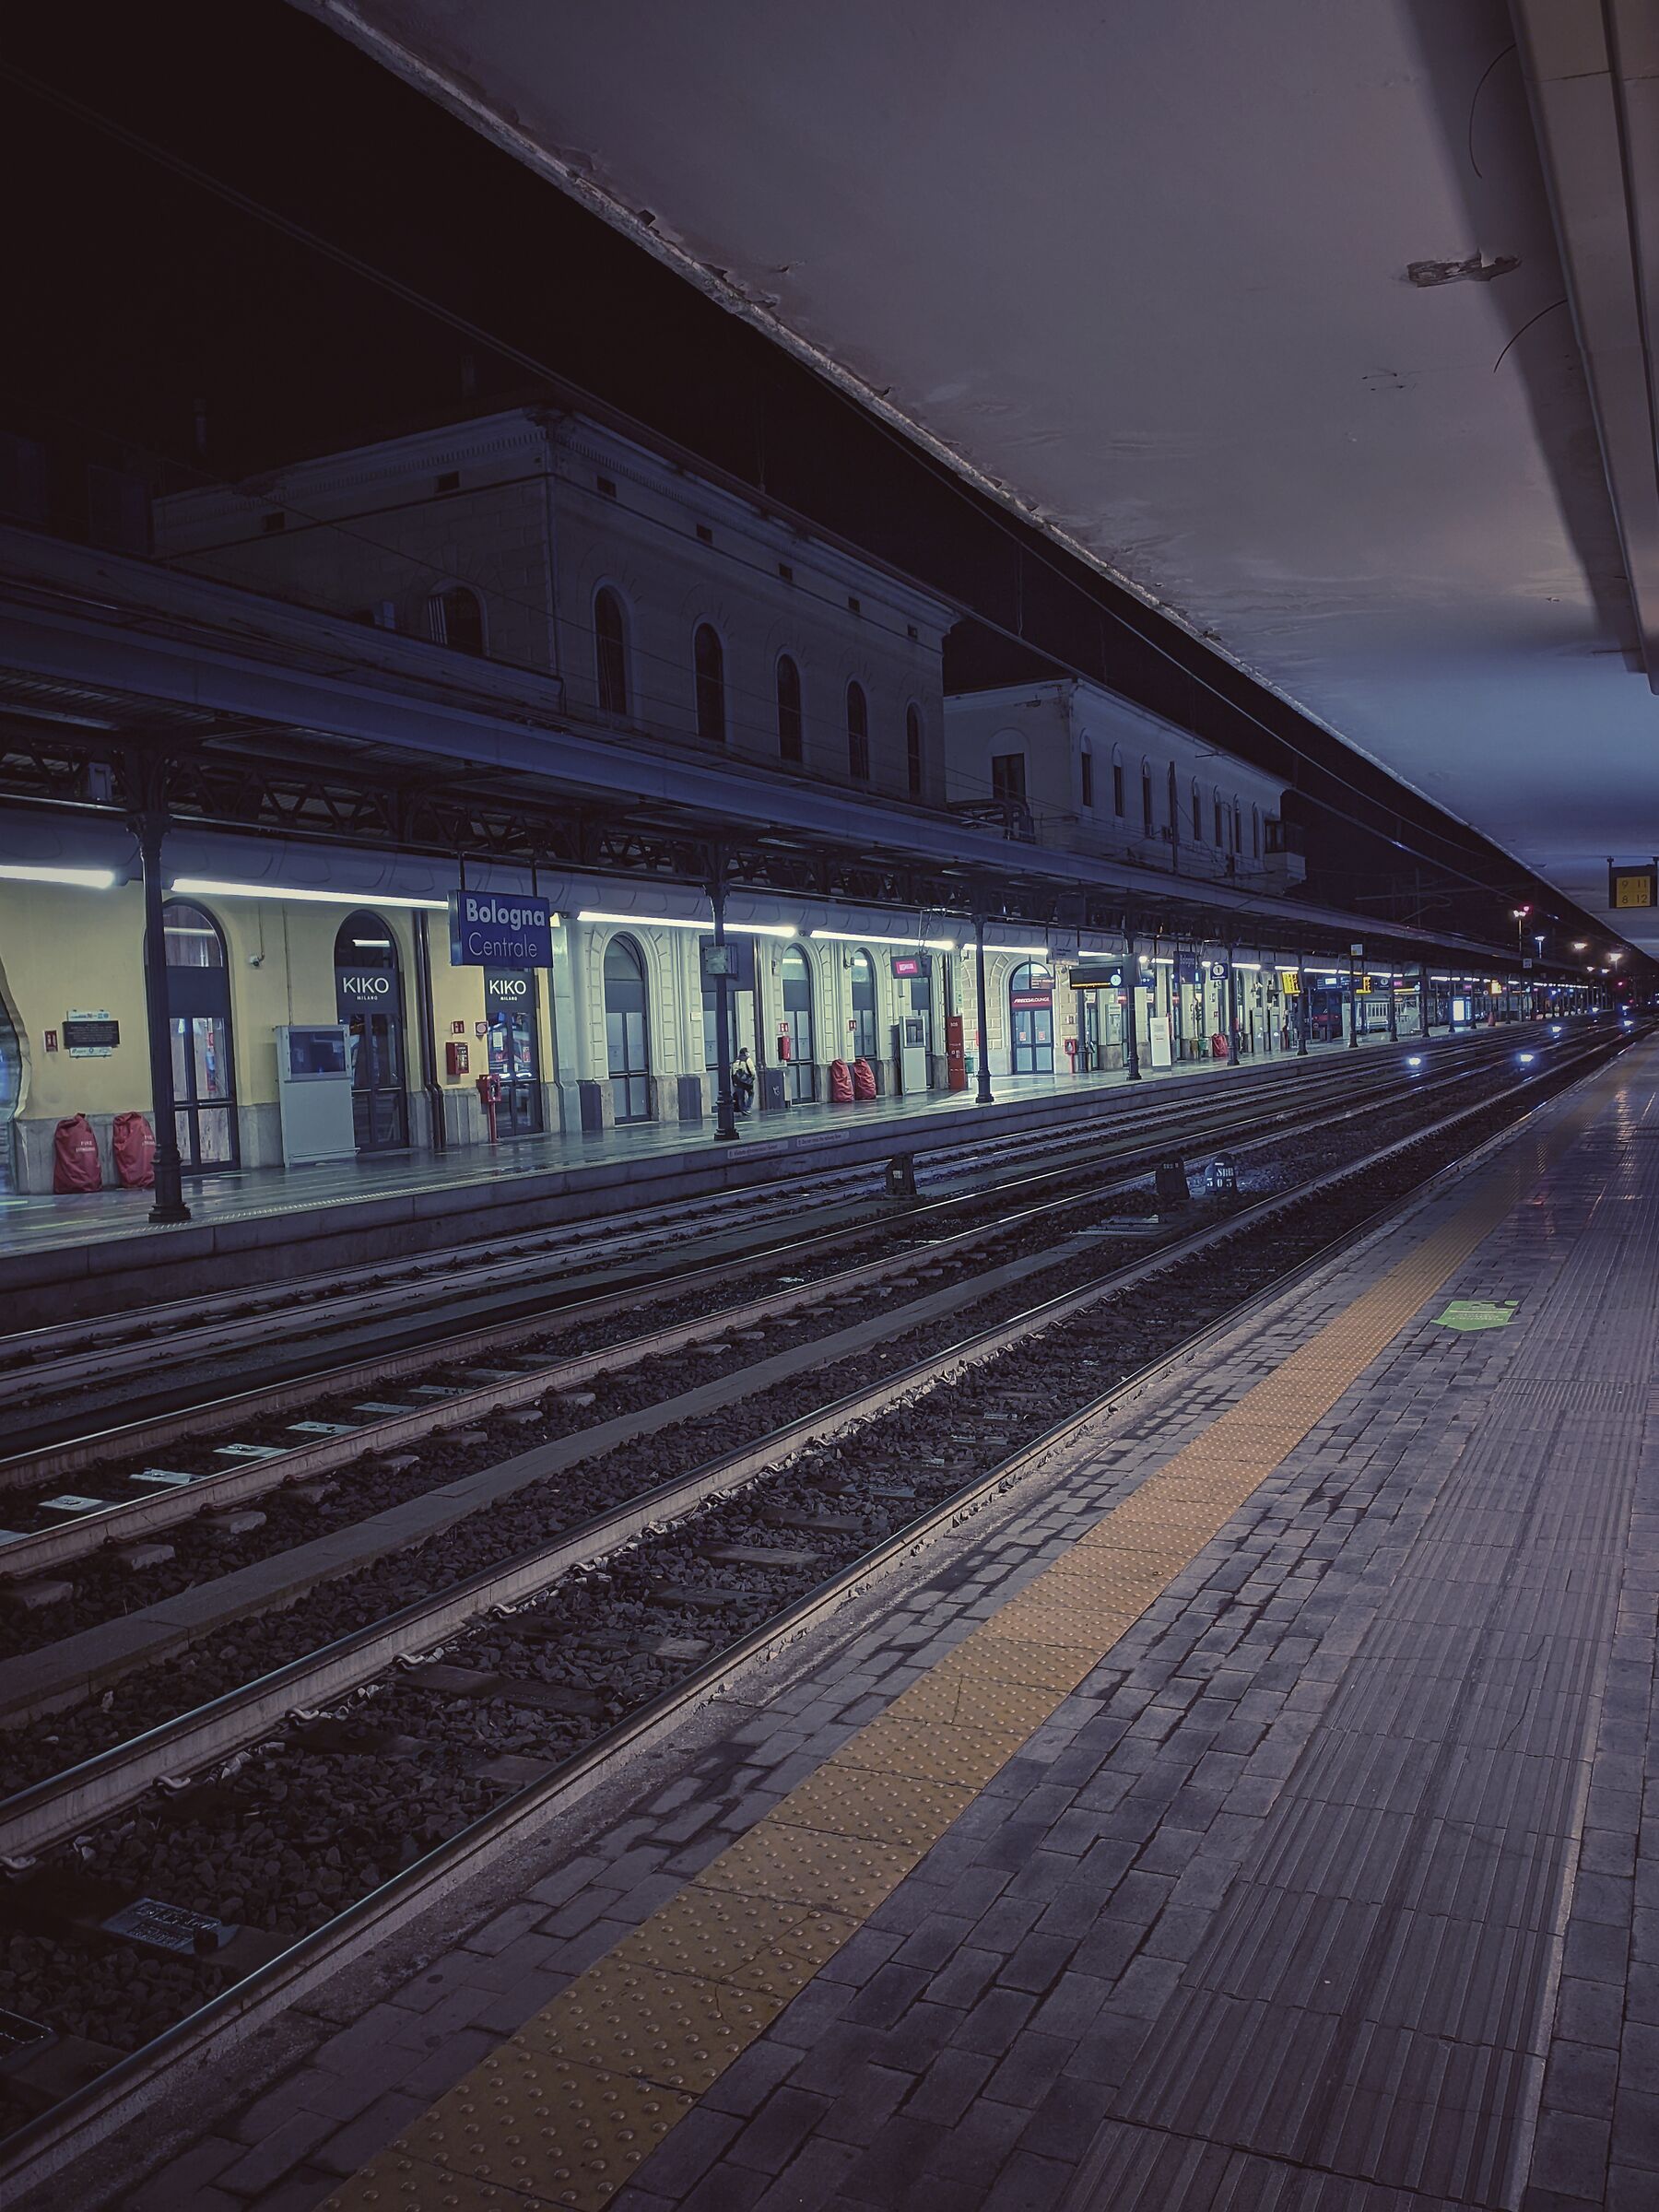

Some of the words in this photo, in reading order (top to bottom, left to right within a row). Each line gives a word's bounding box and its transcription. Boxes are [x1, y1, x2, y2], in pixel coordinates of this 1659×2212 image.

[1622, 880, 1629, 889] 9
[1637, 879, 1647, 888] 11
[1622, 895, 1629, 903] 8
[1637, 894, 1647, 903] 12
[465, 898, 546, 931] Bologna
[468, 932, 537, 958] Centrale
[343, 977, 389, 994] KIKO
[489, 980, 526, 994] KIKO
